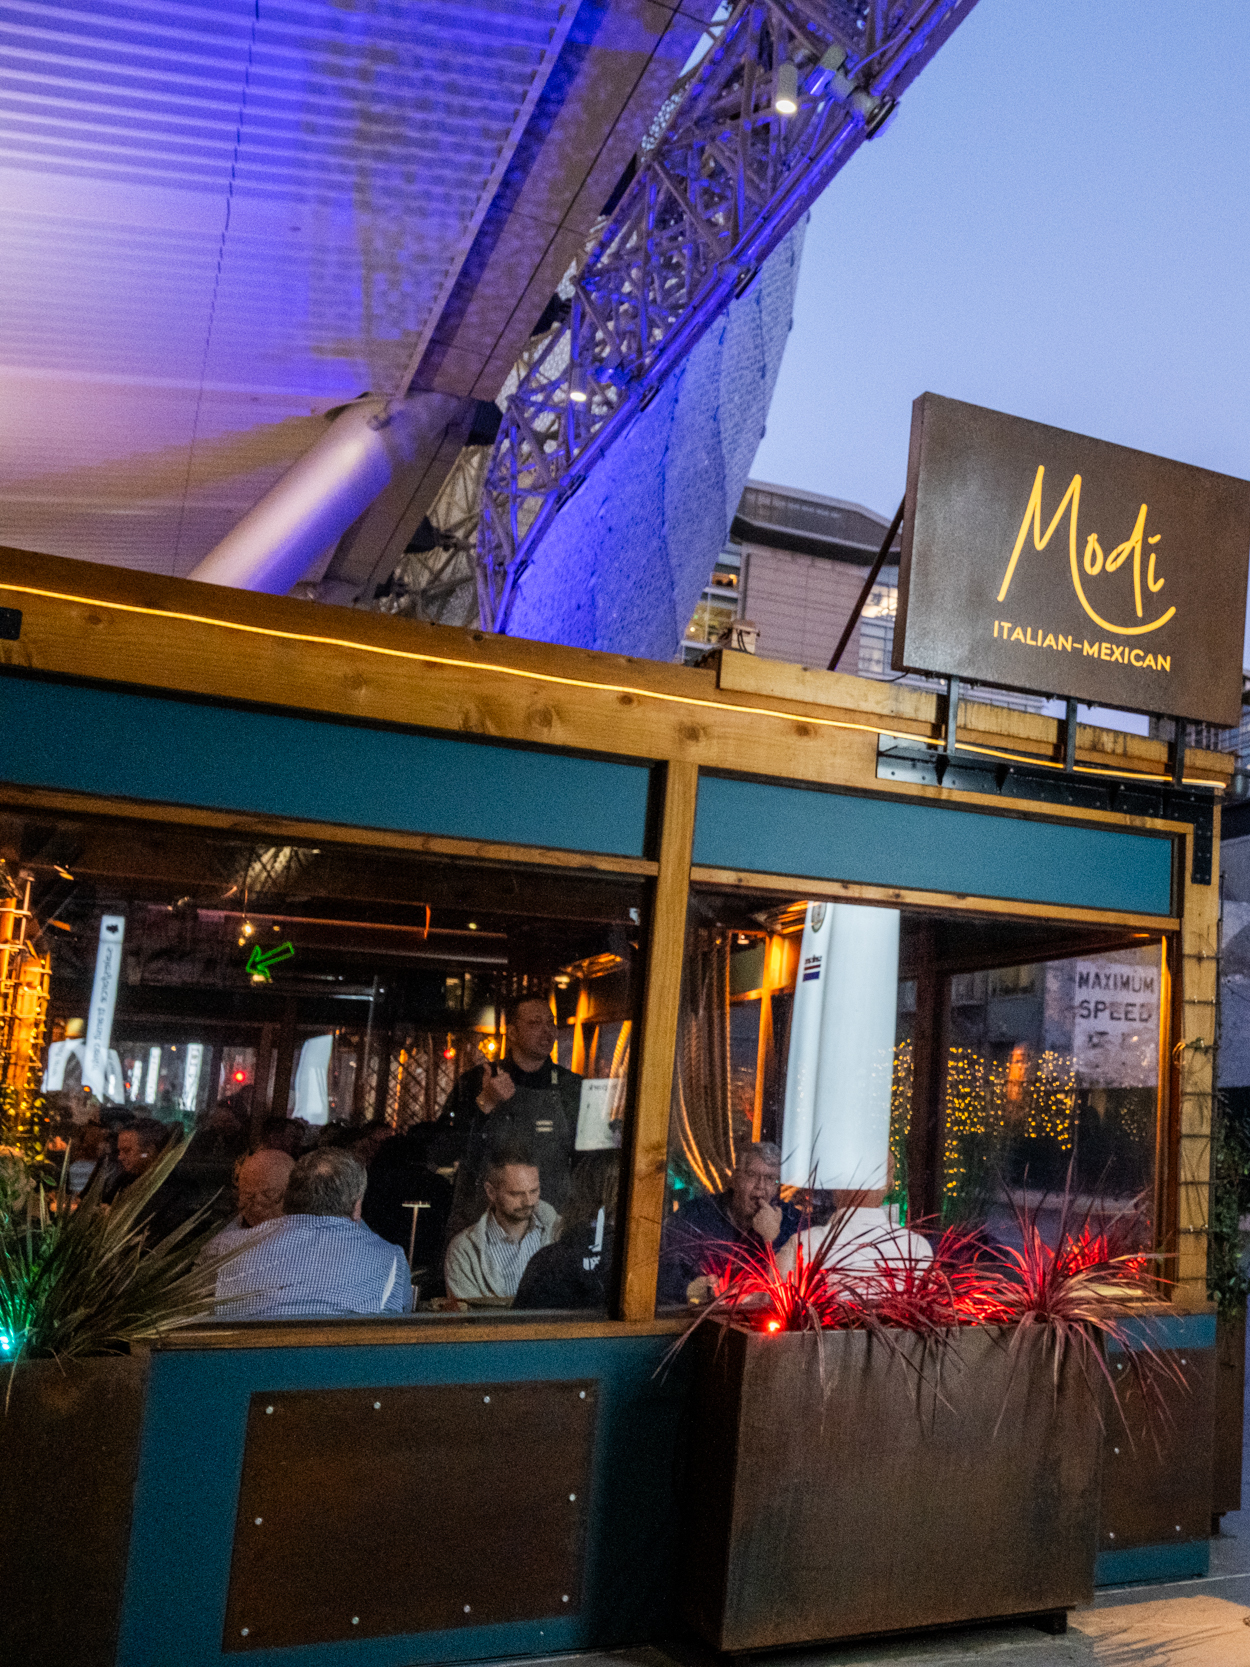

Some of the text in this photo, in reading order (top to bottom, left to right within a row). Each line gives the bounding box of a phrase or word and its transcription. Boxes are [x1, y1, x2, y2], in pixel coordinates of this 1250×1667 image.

[996, 464, 1176, 636] Modi
[993, 619, 1172, 673] ITALIAN-MEXICAN
[1078, 972, 1154, 994] MAXIMUM
